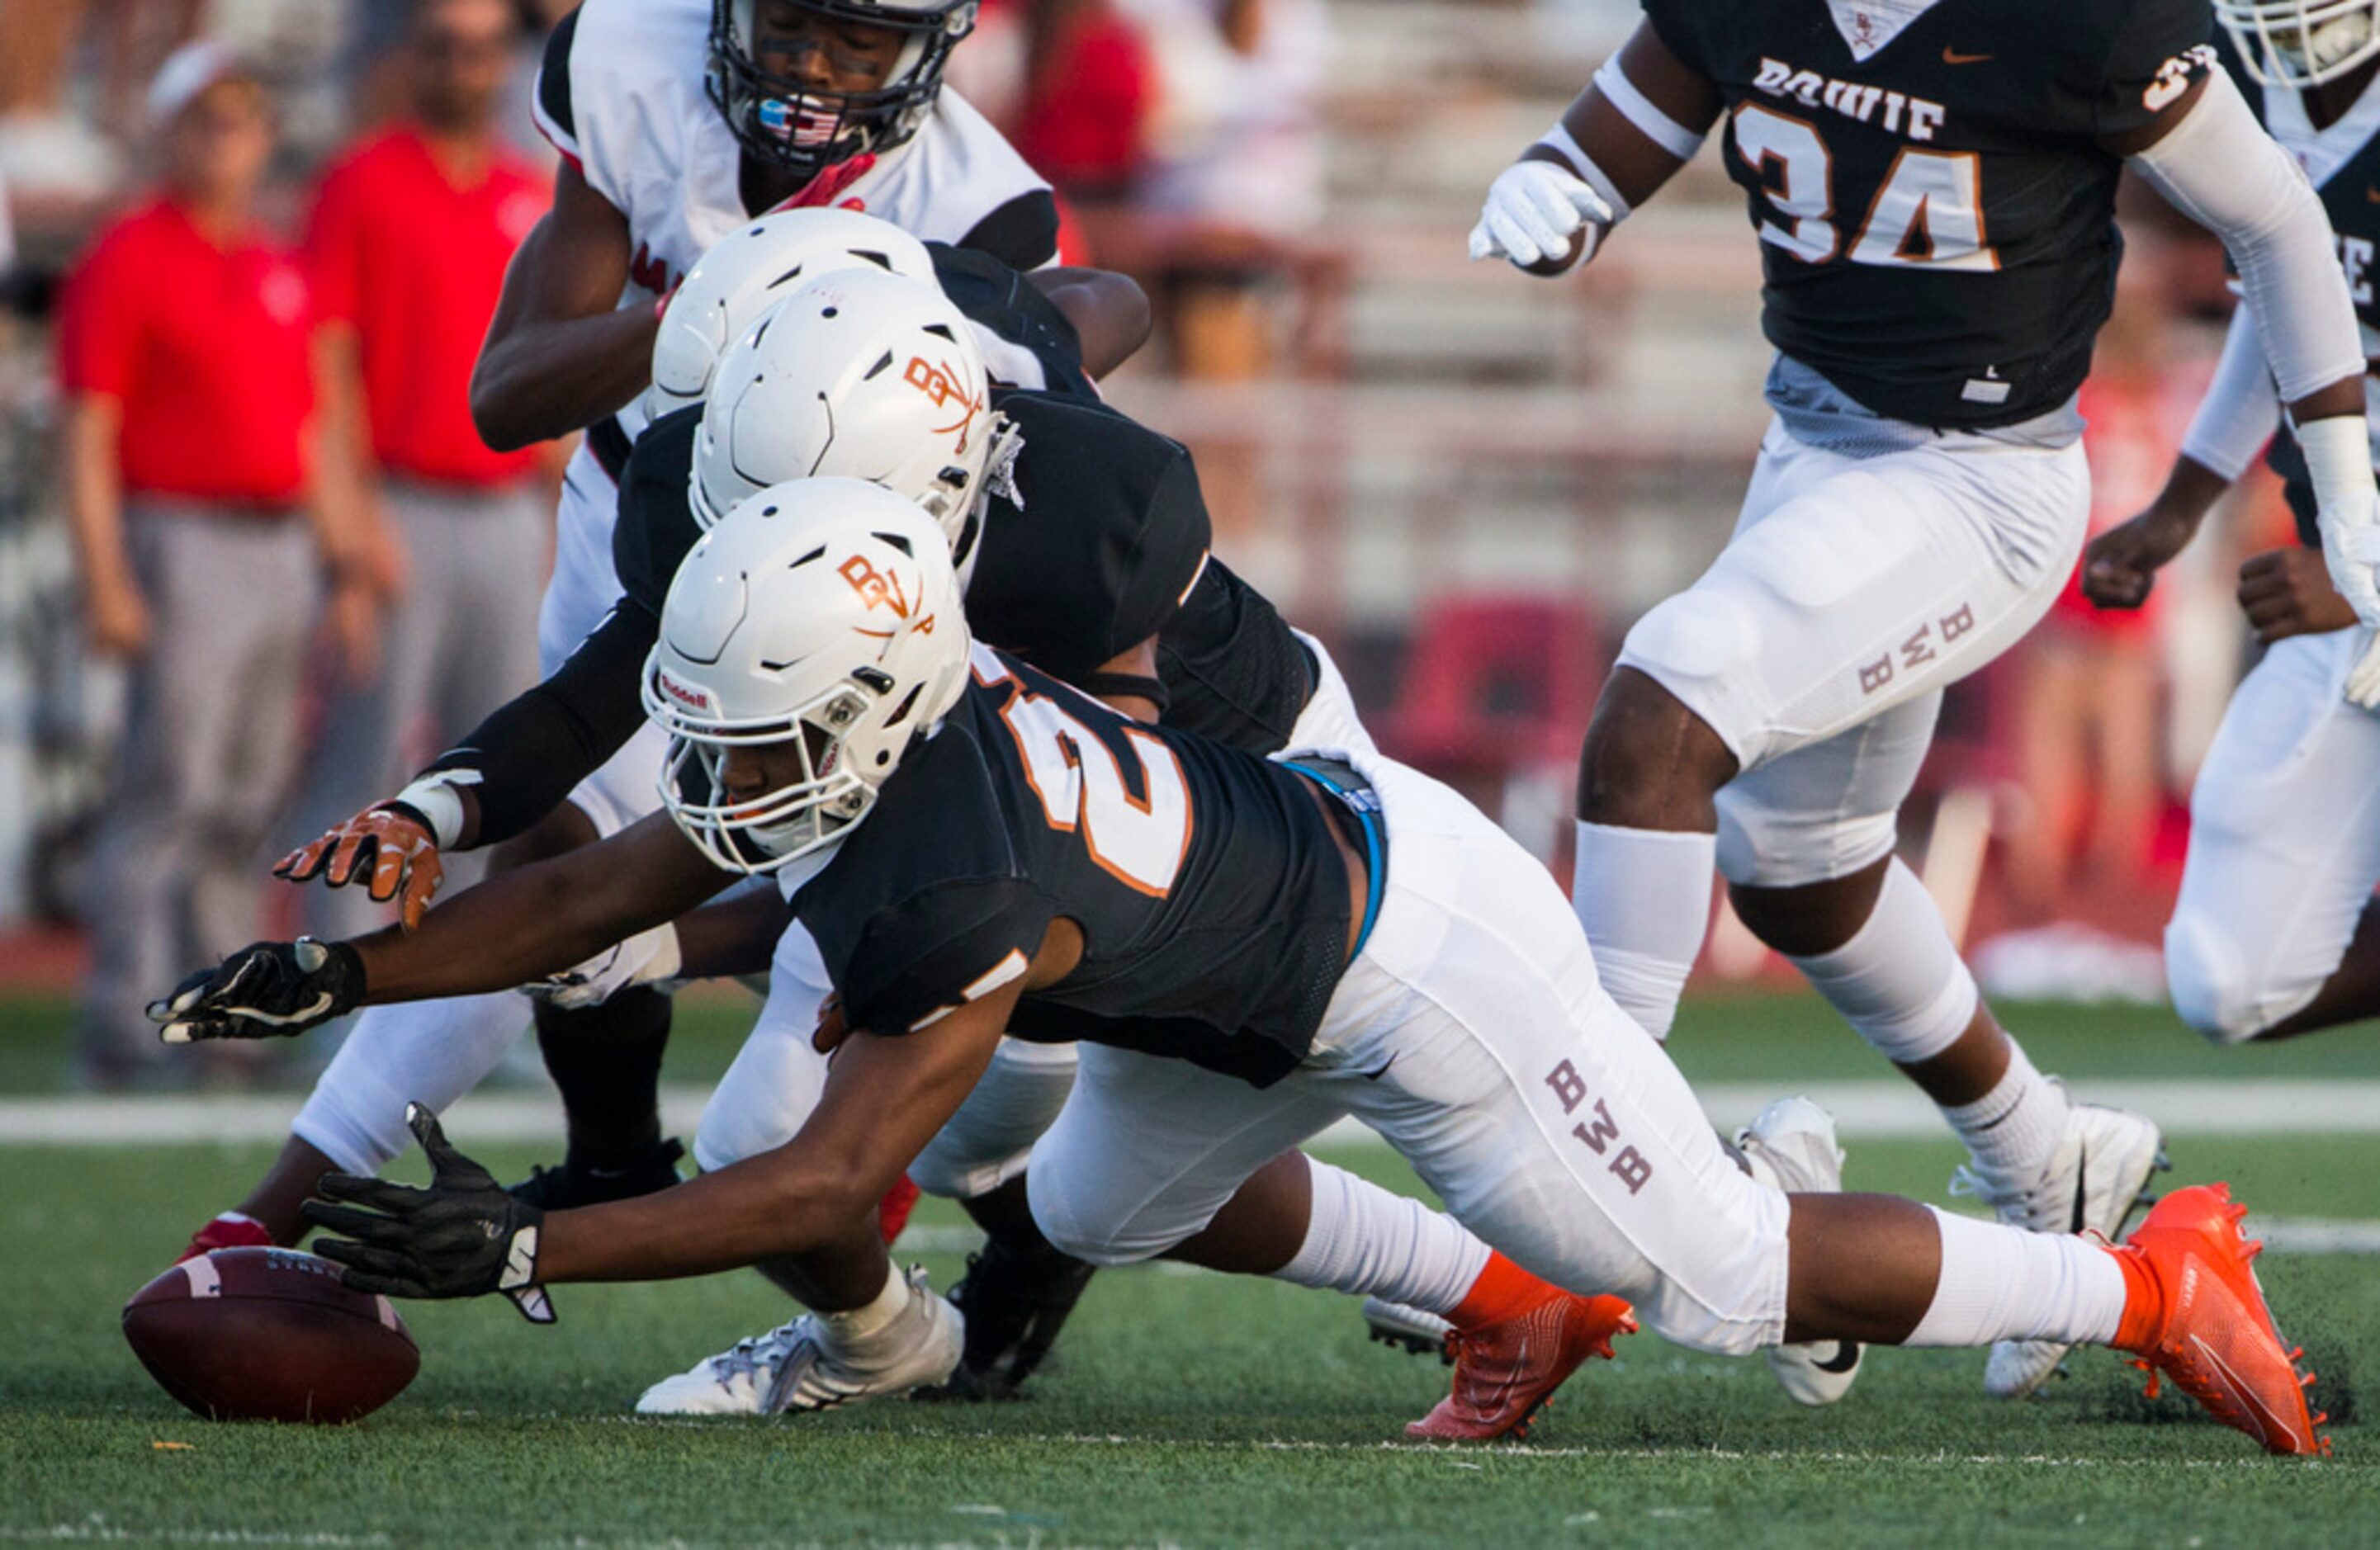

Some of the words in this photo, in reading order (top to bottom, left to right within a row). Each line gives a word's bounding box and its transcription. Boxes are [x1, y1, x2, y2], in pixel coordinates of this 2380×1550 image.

[1732, 98, 2002, 275] 34
[1857, 601, 1975, 696] BWB
[1545, 1058, 1653, 1196] BWB
